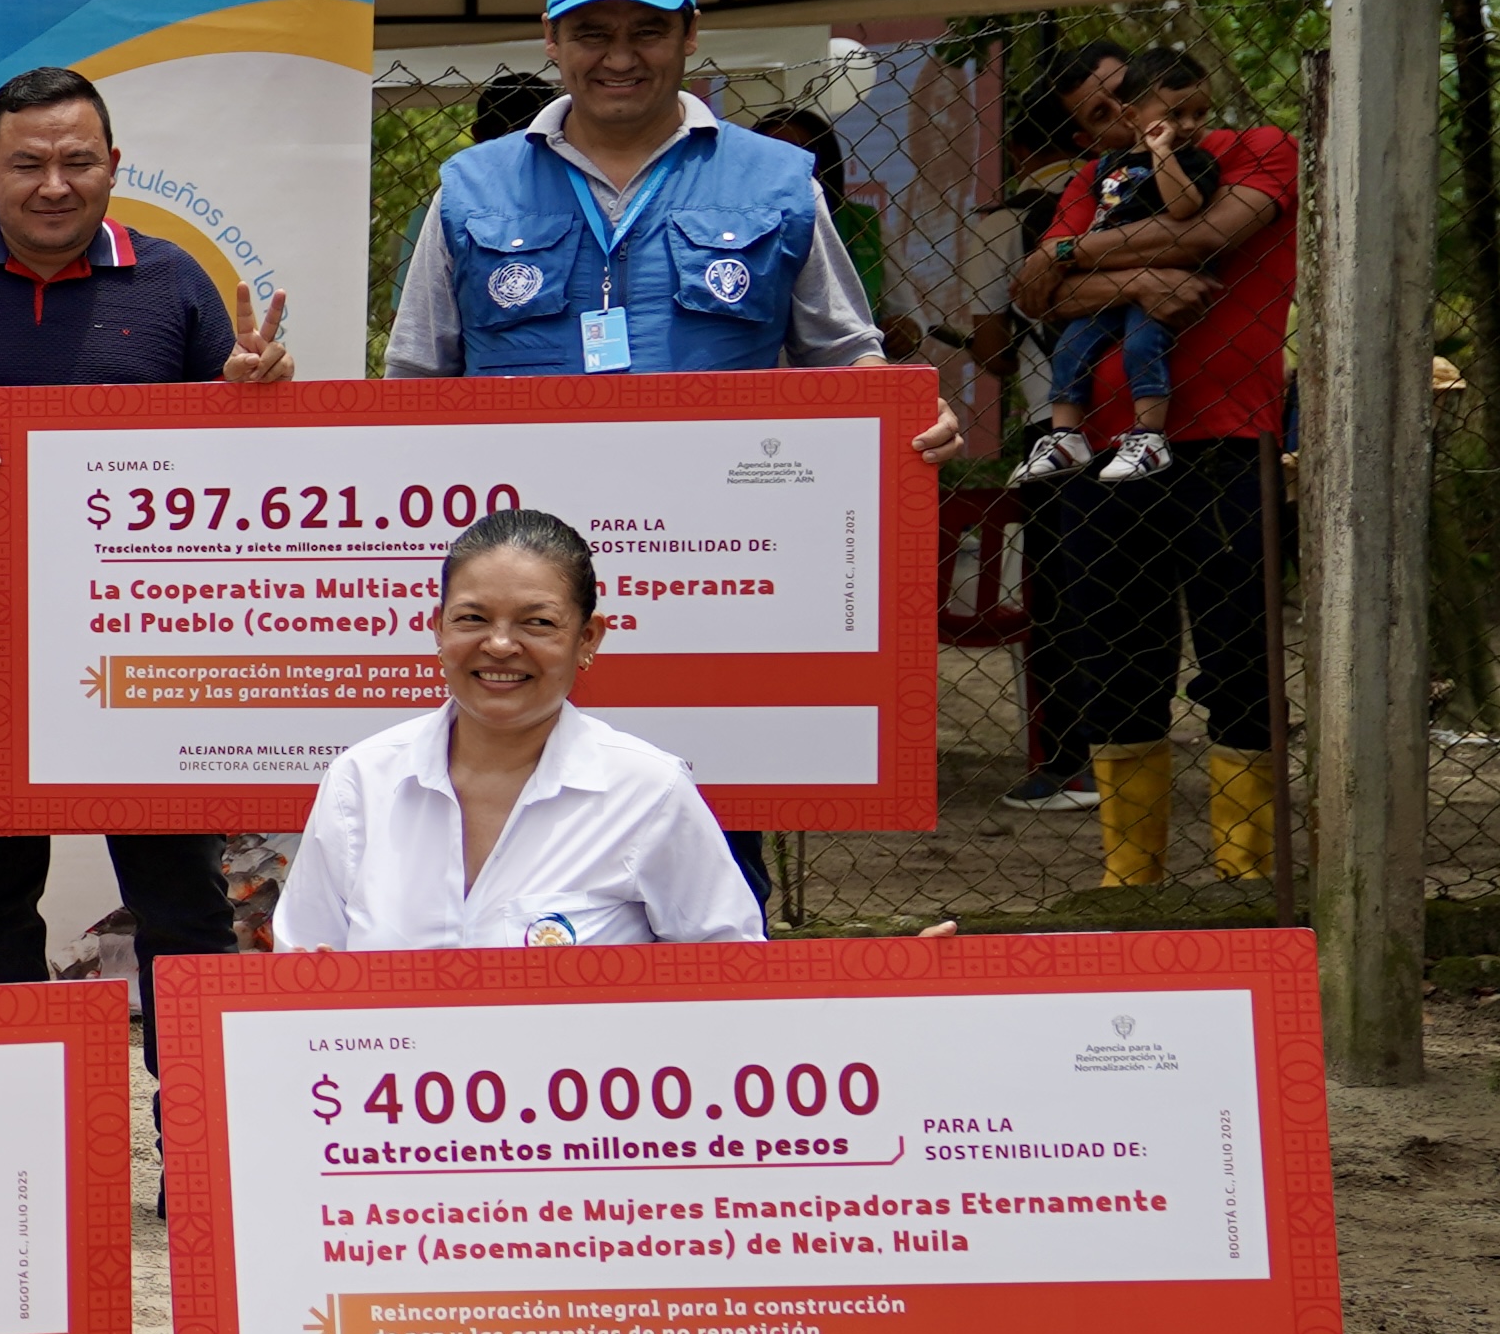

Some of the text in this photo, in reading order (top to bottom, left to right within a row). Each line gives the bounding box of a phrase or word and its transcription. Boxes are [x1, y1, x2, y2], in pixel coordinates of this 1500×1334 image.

[115, 167, 274, 301] rtuleños por la
[18, 1170, 28, 1200] 2025
[18, 1204, 29, 1237] JULIO
[321, 1189, 1167, 1226] La Asociación de Mujeres Emancipadoras Eternamente
[323, 1228, 968, 1266] Mujer (Asoemancipadoras) de Neiva, Huila
